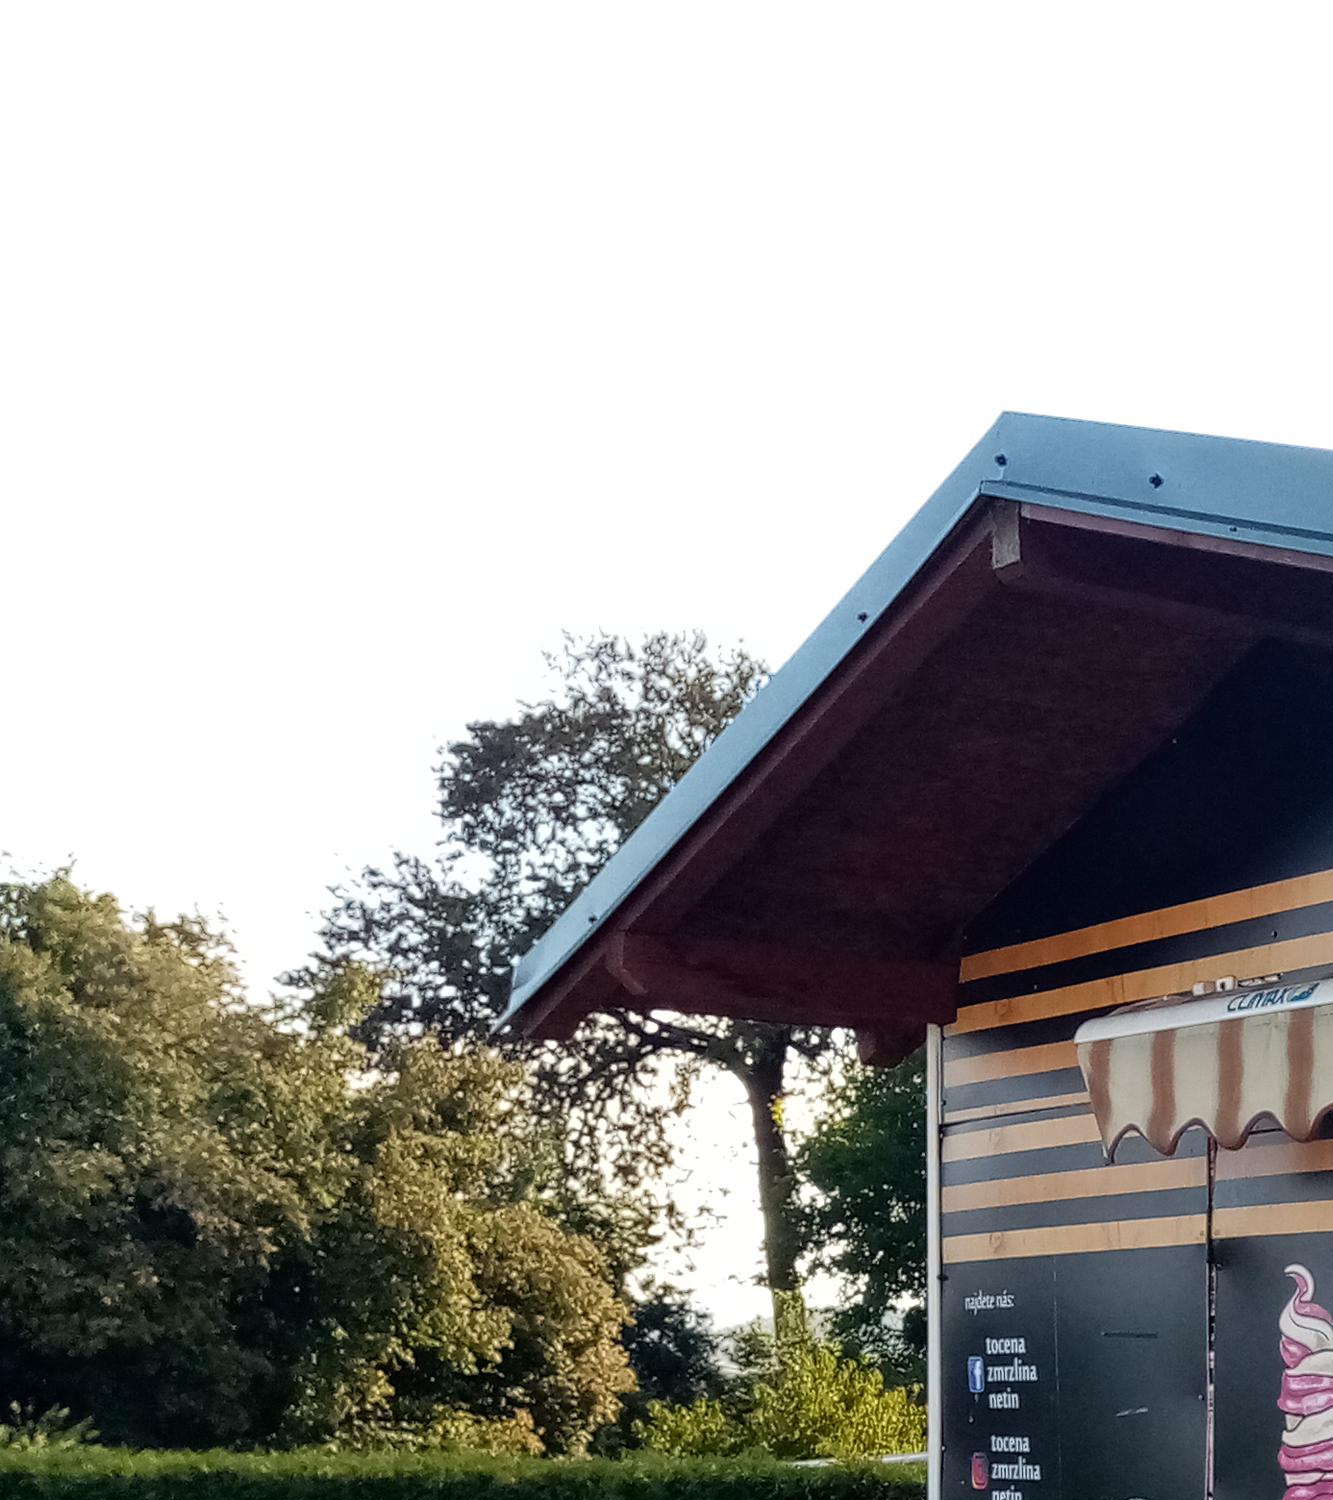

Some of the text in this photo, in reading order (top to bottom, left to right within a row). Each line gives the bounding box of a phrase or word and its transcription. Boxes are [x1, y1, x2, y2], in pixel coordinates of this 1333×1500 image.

[1227, 987, 1291, 1012] CLIMAX
[964, 1289, 1015, 1316] najdete nás:
[986, 1337, 1026, 1355] tocena
[986, 1357, 1038, 1382] zmrzlina
[988, 1388, 1019, 1410] netin
[990, 1434, 1030, 1453] tocena
[991, 1455, 1042, 1481] zmrzlina
